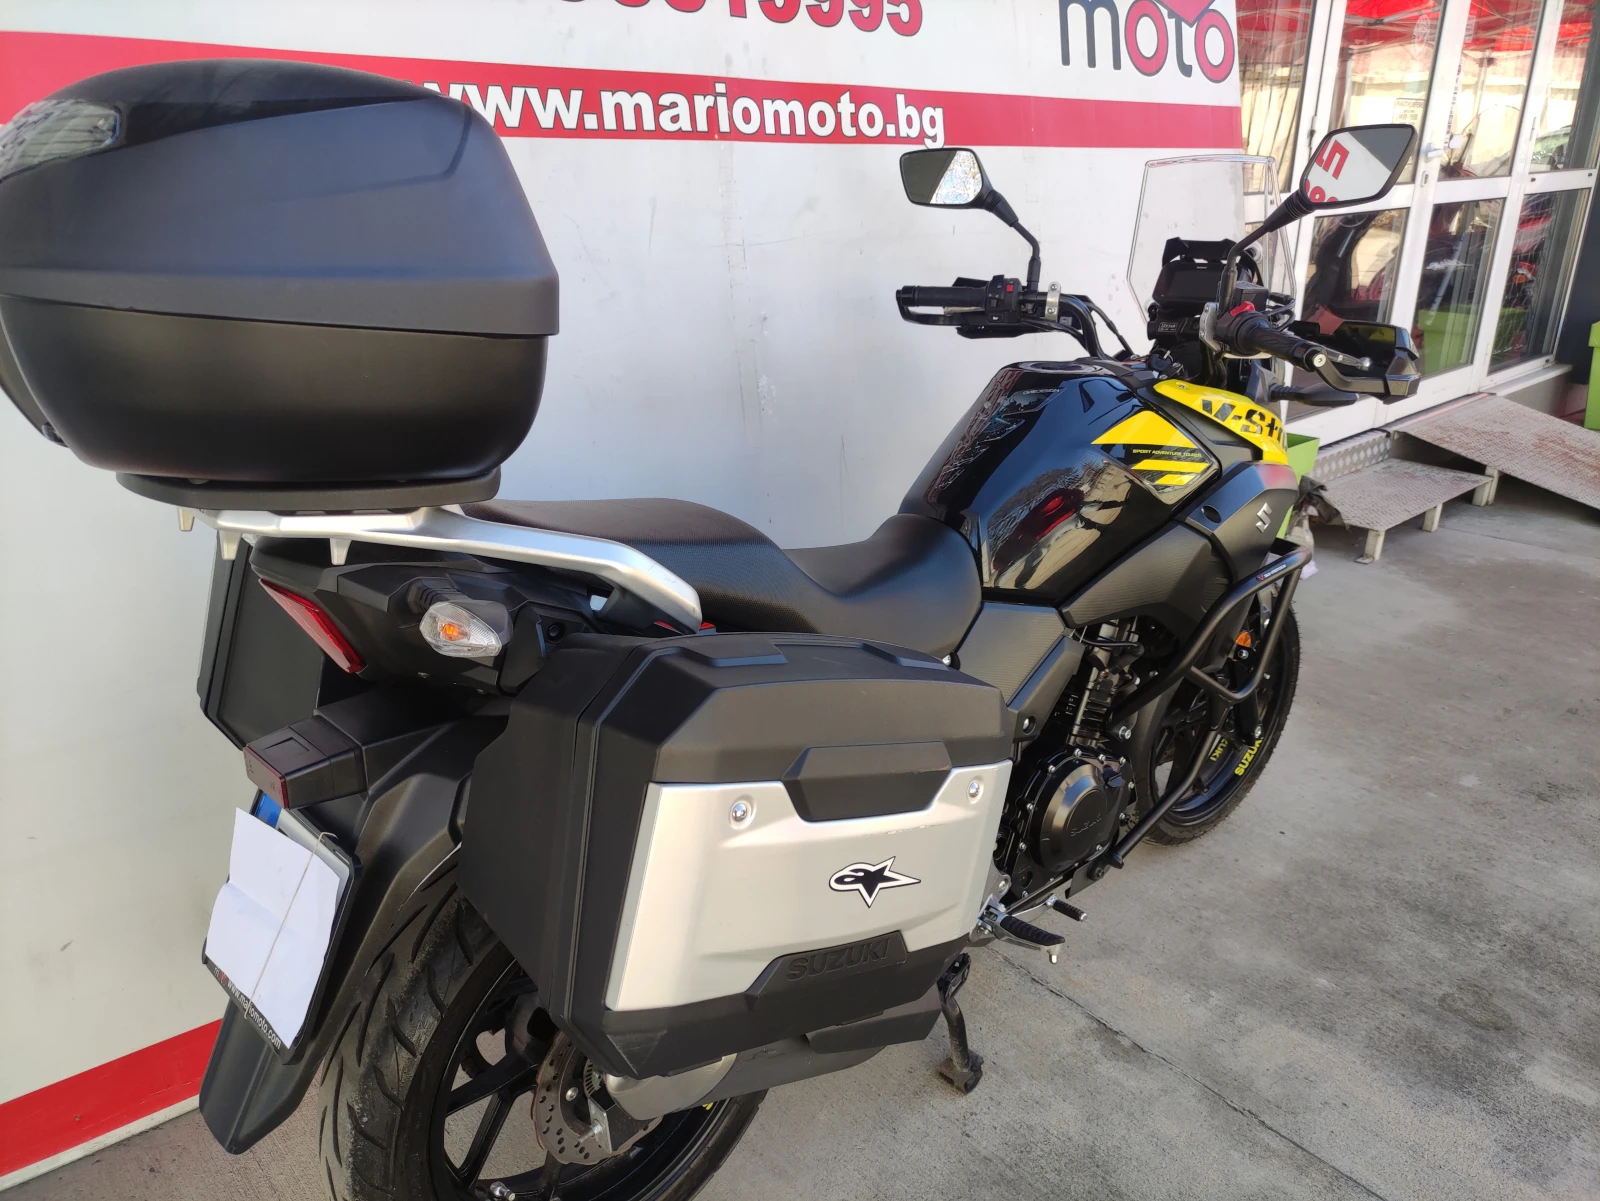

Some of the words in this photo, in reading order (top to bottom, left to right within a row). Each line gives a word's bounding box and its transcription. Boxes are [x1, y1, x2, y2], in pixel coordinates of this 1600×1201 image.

[403, 79, 945, 148] ww.mariomoto.bg
[1234, 736, 1264, 776] SUZUK
[786, 938, 890, 981] SUZUKI
[227, 981, 282, 1050] www.maiomoto.com
